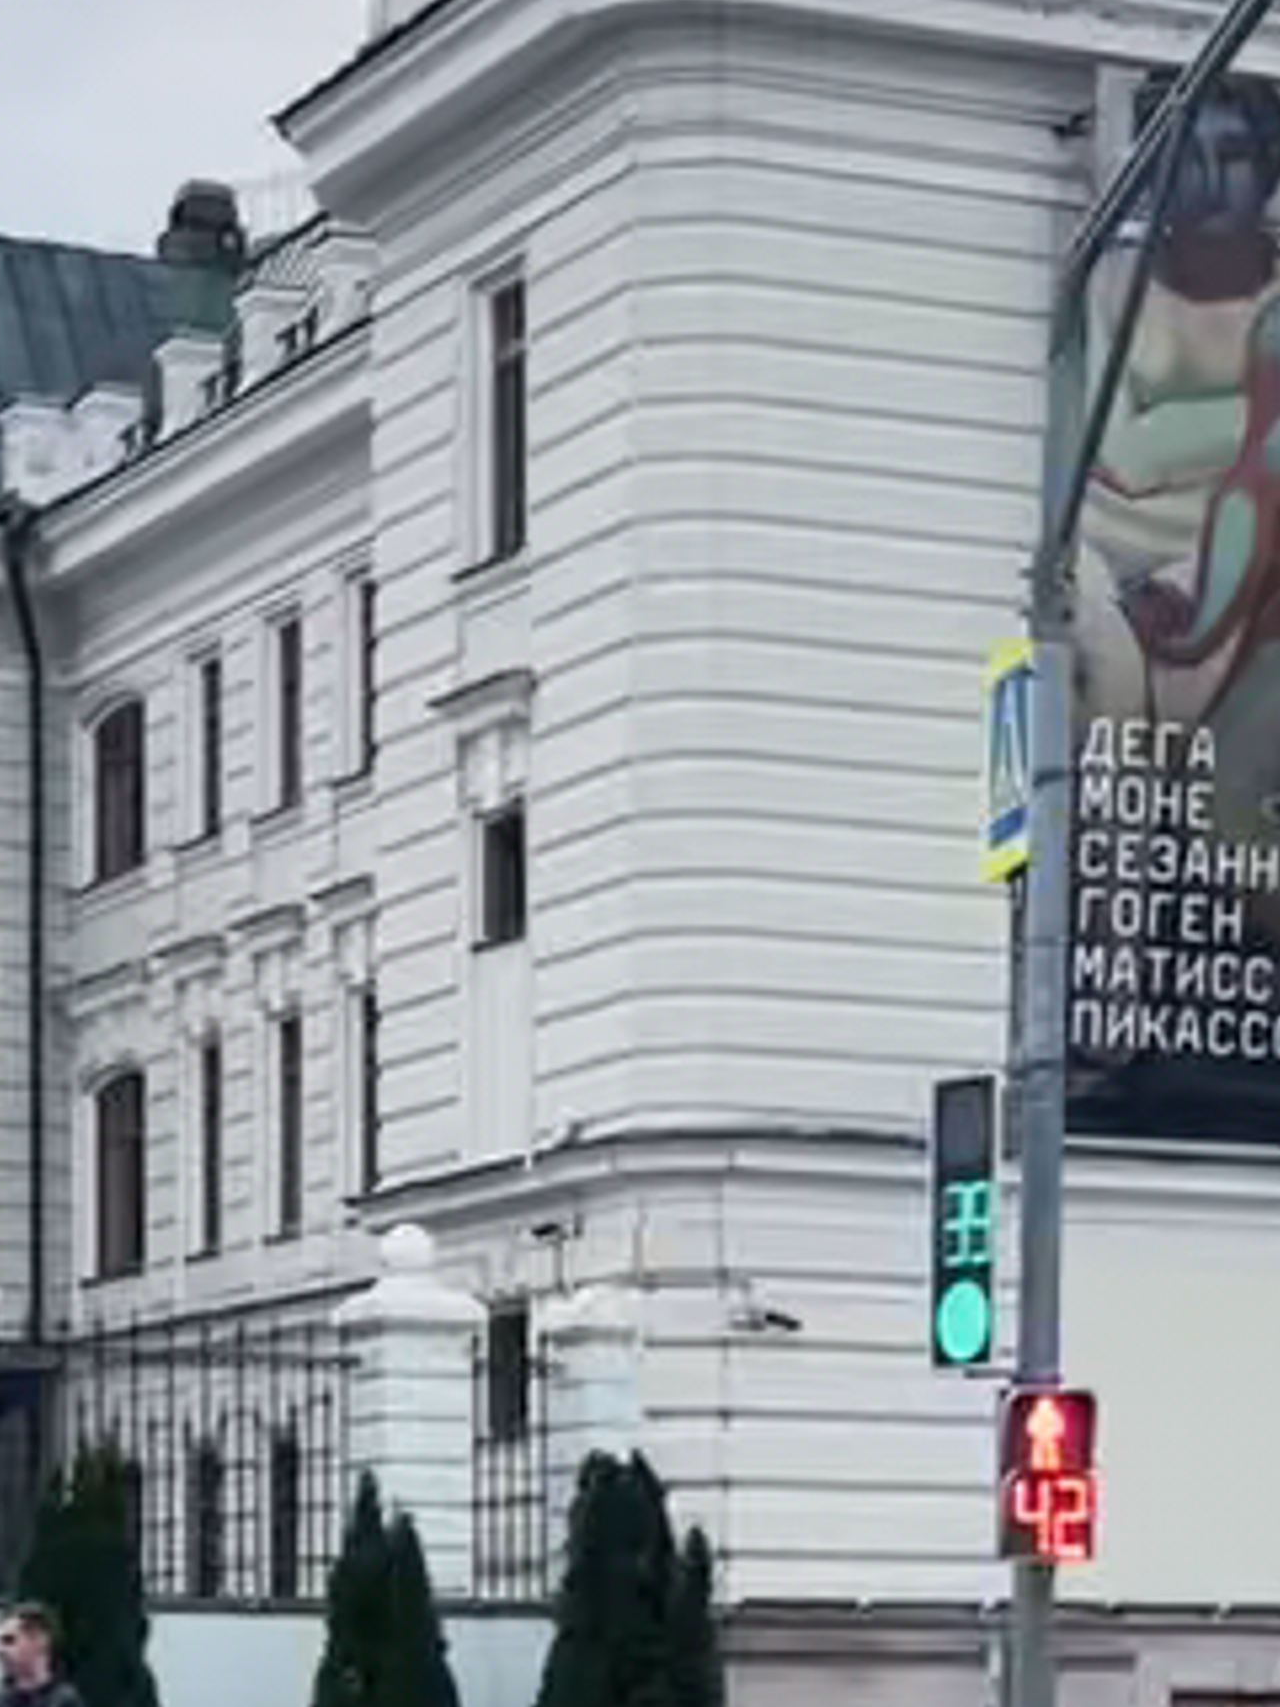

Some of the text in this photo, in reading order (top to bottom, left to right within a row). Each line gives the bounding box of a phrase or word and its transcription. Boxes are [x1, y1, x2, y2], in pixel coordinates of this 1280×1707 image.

[1079, 716, 1216, 772] ДЕГА
[1079, 775, 1215, 831] МОНЕ
[1078, 829, 1280, 894] СЕЗАНН
[1078, 887, 1243, 945] ГОГЕН
[1073, 945, 1274, 1004] МАТИСС
[1015, 1479, 1087, 1557] 42
